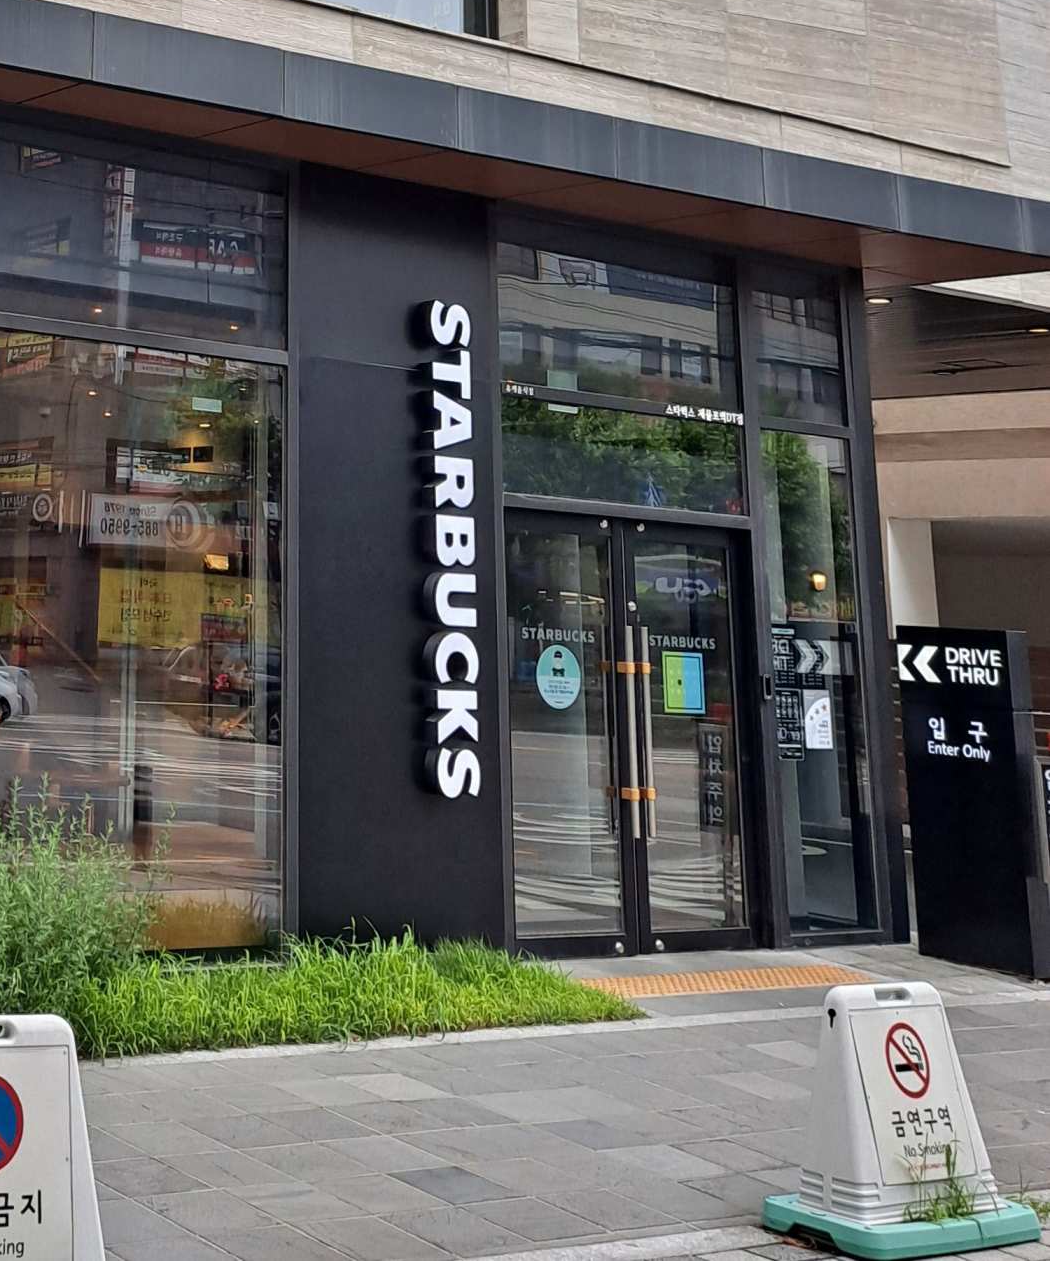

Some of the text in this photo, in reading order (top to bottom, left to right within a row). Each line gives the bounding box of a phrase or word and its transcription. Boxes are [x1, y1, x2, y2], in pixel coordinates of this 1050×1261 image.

[430, 299, 481, 799] STARBUCKS
[521, 626, 595, 643] STARBUCKS
[649, 634, 716, 650] STARBUCKS
[944, 646, 1003, 668] DRIVE
[946, 665, 999, 686] THRU
[927, 741, 991, 762] Enter Only
[891, 1104, 953, 1137] 금연구역
[903, 1144, 917, 1158] No
